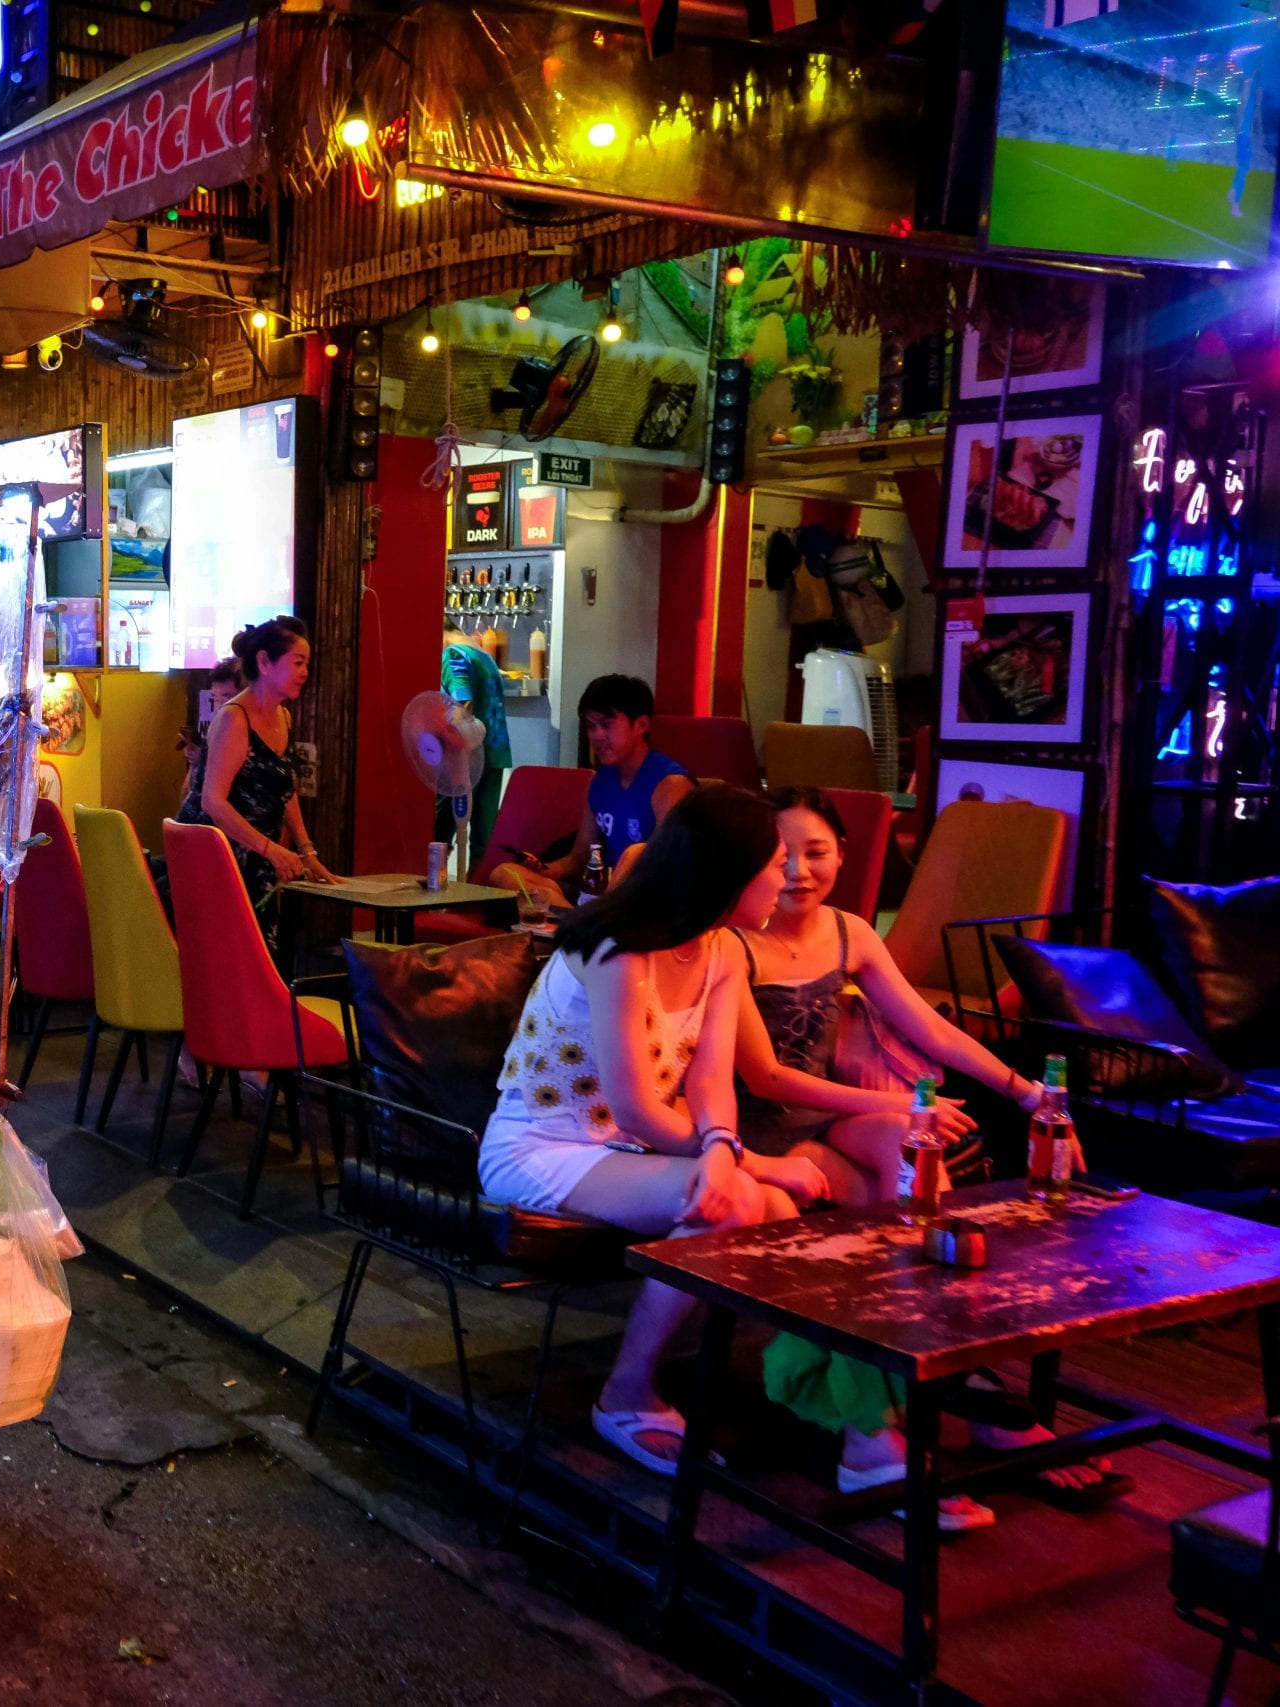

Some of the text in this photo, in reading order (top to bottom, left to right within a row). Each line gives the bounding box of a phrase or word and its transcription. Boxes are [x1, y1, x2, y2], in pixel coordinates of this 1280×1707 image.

[74, 61, 256, 204] Chicke
[550, 457, 581, 471] EXIT
[466, 528, 498, 542] DARK
[527, 527, 547, 539] IPA
